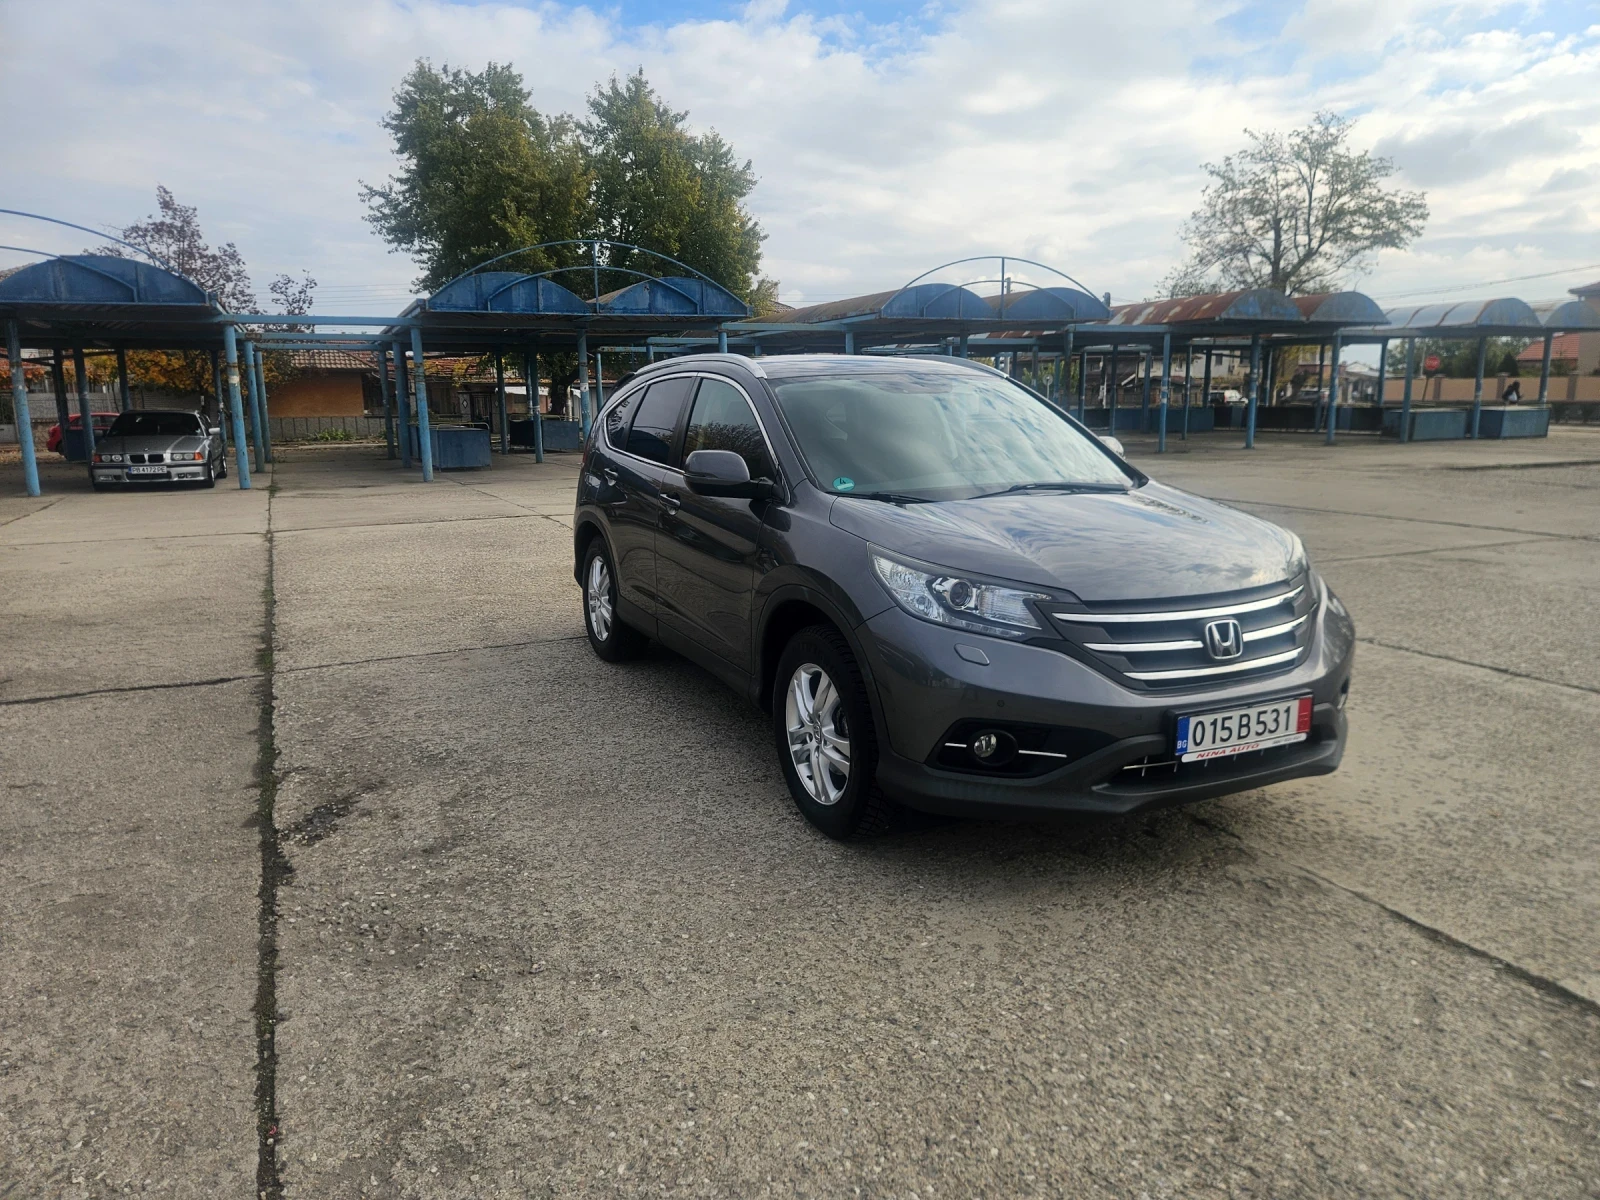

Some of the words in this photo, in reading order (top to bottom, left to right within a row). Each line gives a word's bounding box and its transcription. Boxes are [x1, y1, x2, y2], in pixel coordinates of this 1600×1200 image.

[1177, 740, 1188, 749] BG
[1196, 749, 1226, 759] NINA
[1229, 743, 1260, 753] AUTO
